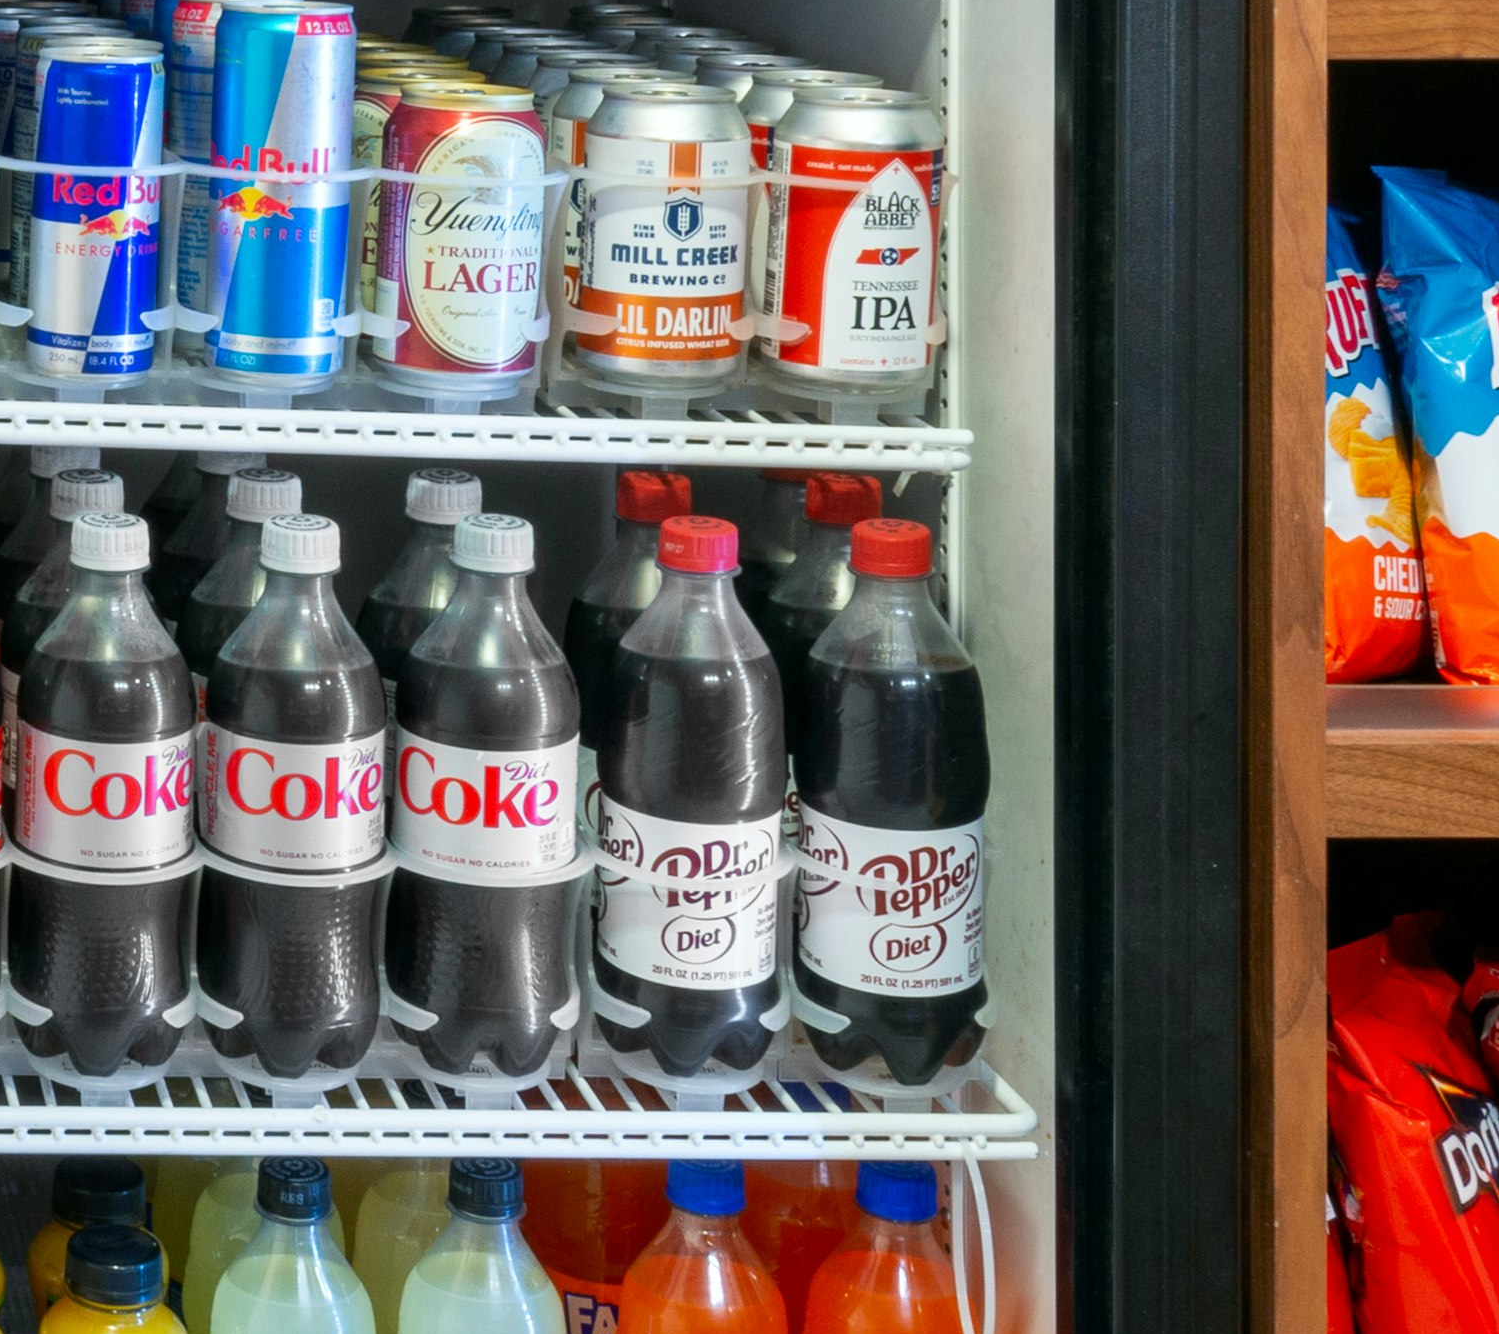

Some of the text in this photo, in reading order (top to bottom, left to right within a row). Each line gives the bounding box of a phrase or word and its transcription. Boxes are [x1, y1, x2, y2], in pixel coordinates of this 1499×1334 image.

[305, 20, 322, 34] 12
[53, 176, 120, 206] Red
[407, 190, 542, 239] Yuengling
[865, 193, 920, 215] BLACK
[865, 209, 920, 226] ABBEY
[438, 245, 535, 258] TRADITIONAL
[610, 243, 738, 265] MILL CREEK
[423, 262, 537, 293] LAGER
[629, 273, 708, 287] BREWING
[852, 279, 918, 291] TENNESSEE
[616, 302, 650, 336] LIL
[851, 296, 915, 330] IPA
[504, 760, 549, 782] Diet
[398, 746, 558, 829] Coke
[422, 849, 530, 868] NO SUGAR NO CALORIES
[911, 840, 955, 881] Dr
[872, 853, 976, 916] Pepper
[885, 934, 930, 960] Diet
